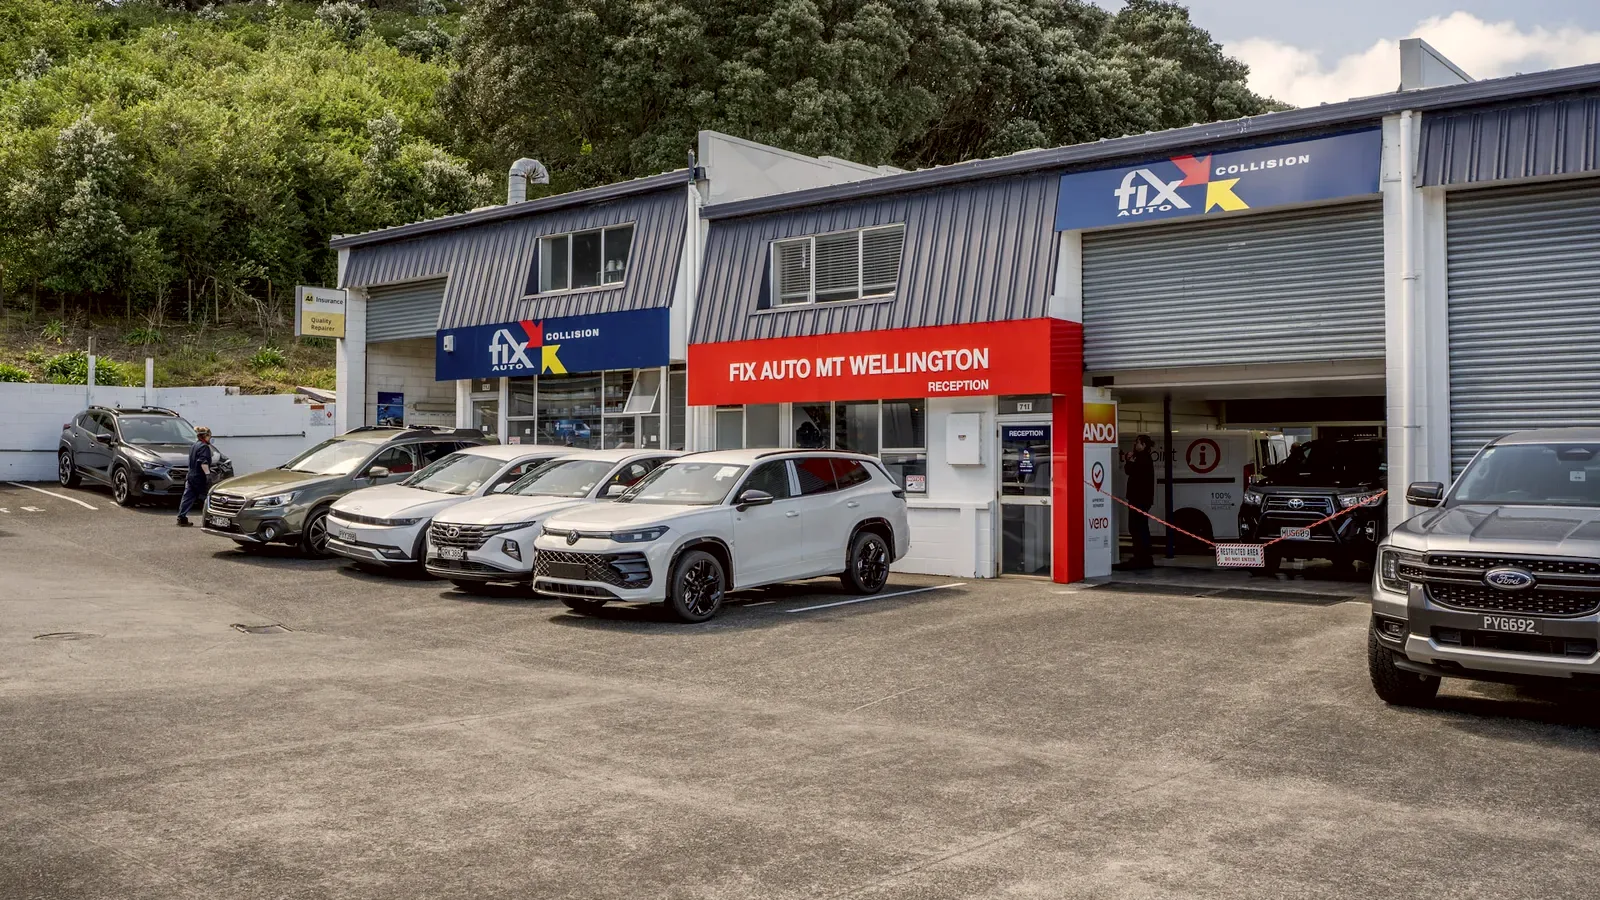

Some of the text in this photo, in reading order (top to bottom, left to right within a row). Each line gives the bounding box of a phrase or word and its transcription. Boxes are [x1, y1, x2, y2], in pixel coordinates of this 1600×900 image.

[1215, 154, 1310, 176] COLLISION
[1117, 204, 1172, 217] AUTO
[315, 296, 344, 305] Insurance
[310, 317, 332, 325] Quality
[310, 324, 335, 332] Repairer
[545, 328, 600, 341] COLLISION
[491, 363, 524, 372] AUTO
[729, 347, 990, 382] FIX AUTO MT WELLINGTON
[927, 379, 990, 393] RECEPTION
[1083, 422, 1115, 442] ANDO
[1211, 492, 1231, 500] 100%
[1088, 517, 1109, 529] vero
[1220, 548, 1246, 556] RESTRICTED
[1496, 574, 1520, 585] Ford
[1483, 616, 1535, 632] PYG692
